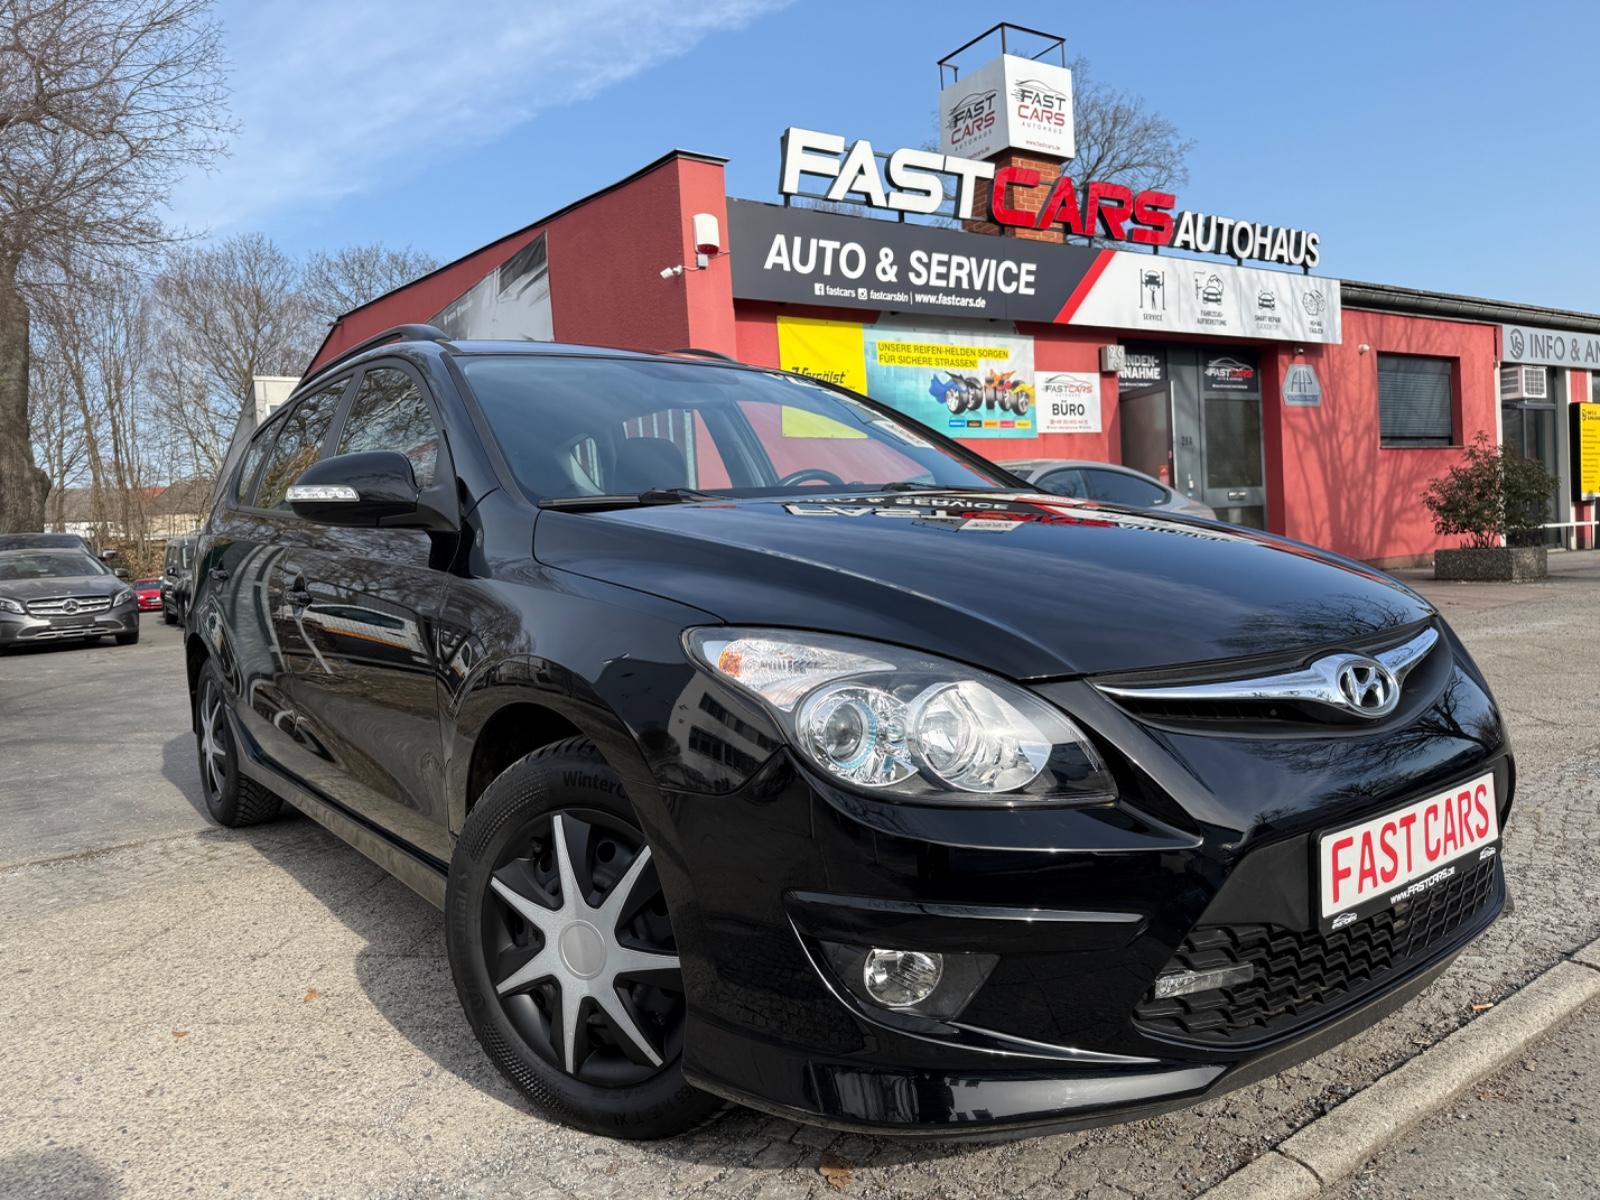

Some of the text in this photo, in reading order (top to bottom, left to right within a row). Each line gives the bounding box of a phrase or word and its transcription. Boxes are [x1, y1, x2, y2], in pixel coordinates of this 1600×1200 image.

[951, 93, 997, 129] FAST
[1016, 89, 1066, 111] FAST
[1017, 105, 1065, 127] CARS
[951, 111, 996, 145] CARS
[1174, 211, 1321, 268] AUTOHAUS
[763, 234, 1037, 296] AUTO & SERVICE
[826, 285, 856, 298] fastcars
[915, 292, 986, 308] www.fastcars.de
[1143, 313, 1163, 321] SERVICE
[878, 342, 1009, 359] UNSERE REIFEN-HELDEN SORGEN
[1530, 334, 1565, 360] INFO
[1570, 338, 1581, 362] &
[879, 353, 978, 369] FÜR SICHERE STRASSEN!
[1052, 399, 1086, 416] BÜRO
[1331, 783, 1490, 904] FAST CARS
